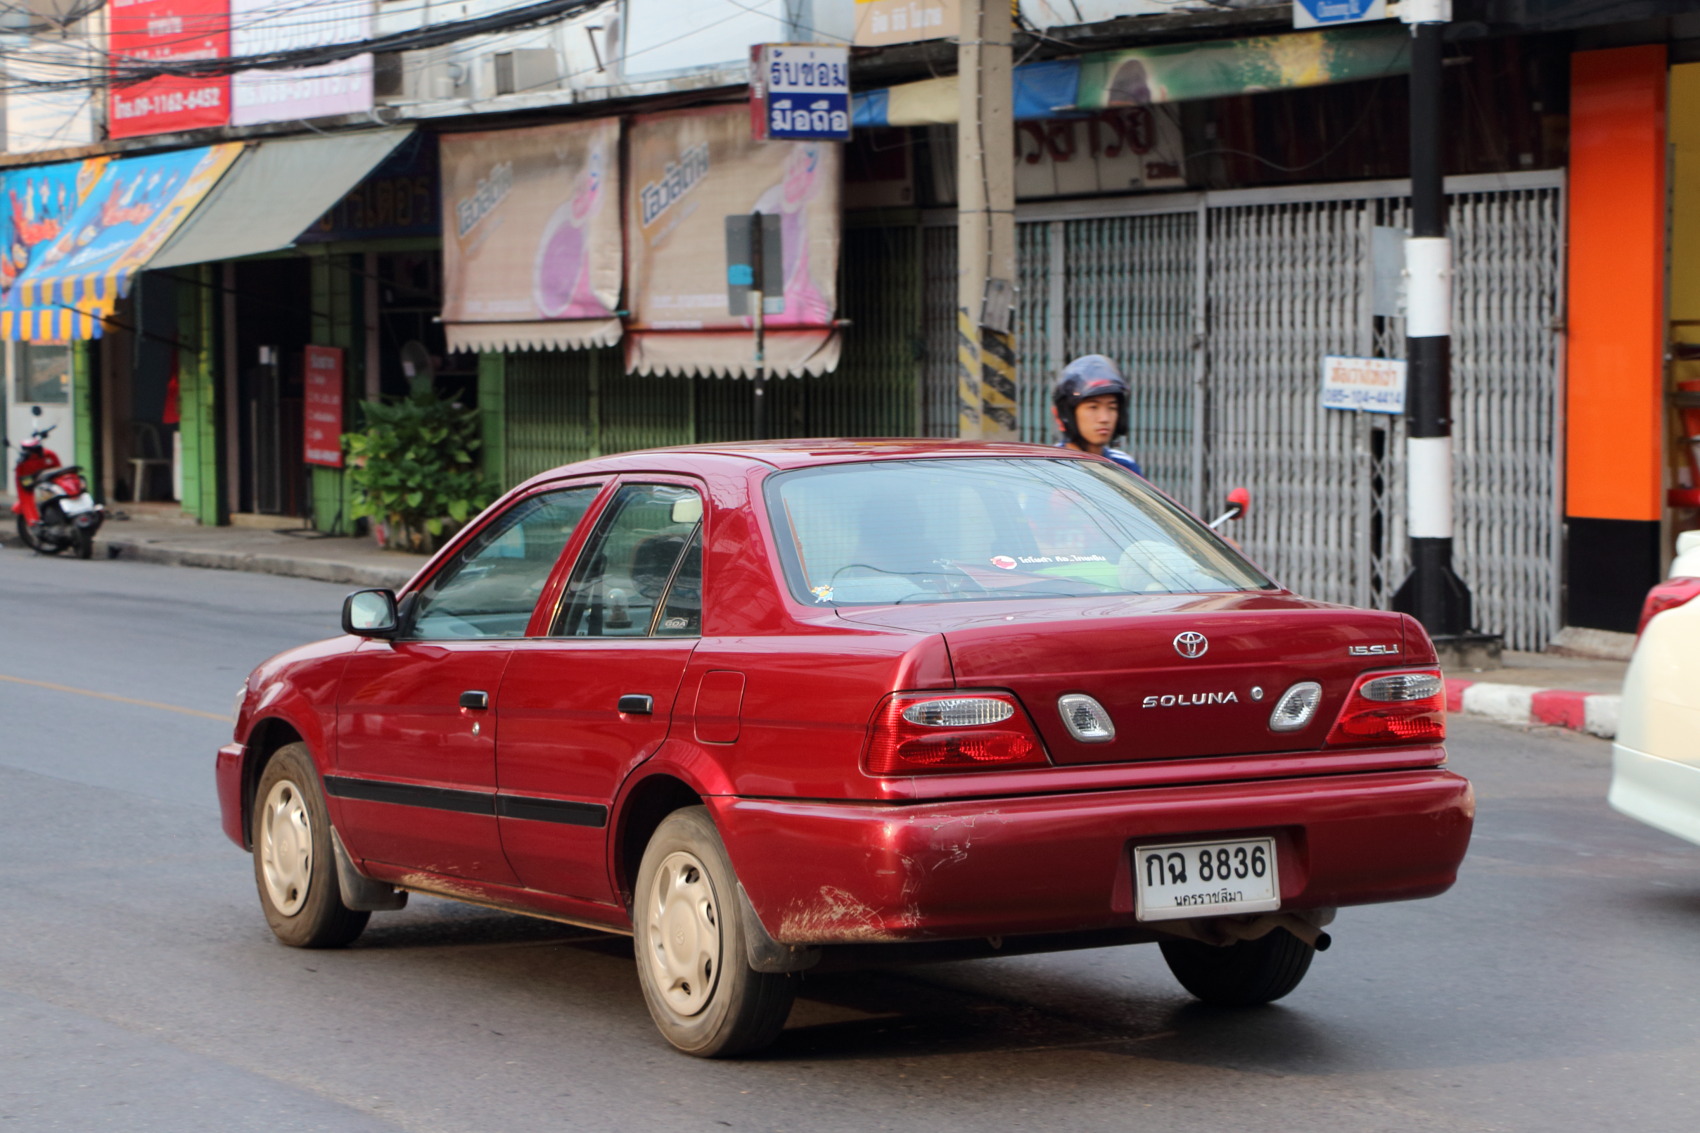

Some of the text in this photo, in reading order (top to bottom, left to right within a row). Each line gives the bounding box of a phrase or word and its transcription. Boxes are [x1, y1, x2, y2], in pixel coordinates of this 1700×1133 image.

[770, 50, 847, 87] รับซ่อม
[771, 99, 848, 132] มือถือ
[665, 618, 688, 629] GOA
[1142, 691, 1239, 709] SOLUNA
[1146, 845, 1266, 886] กฉ 8836
[1174, 888, 1243, 907] นครราชสีมา
